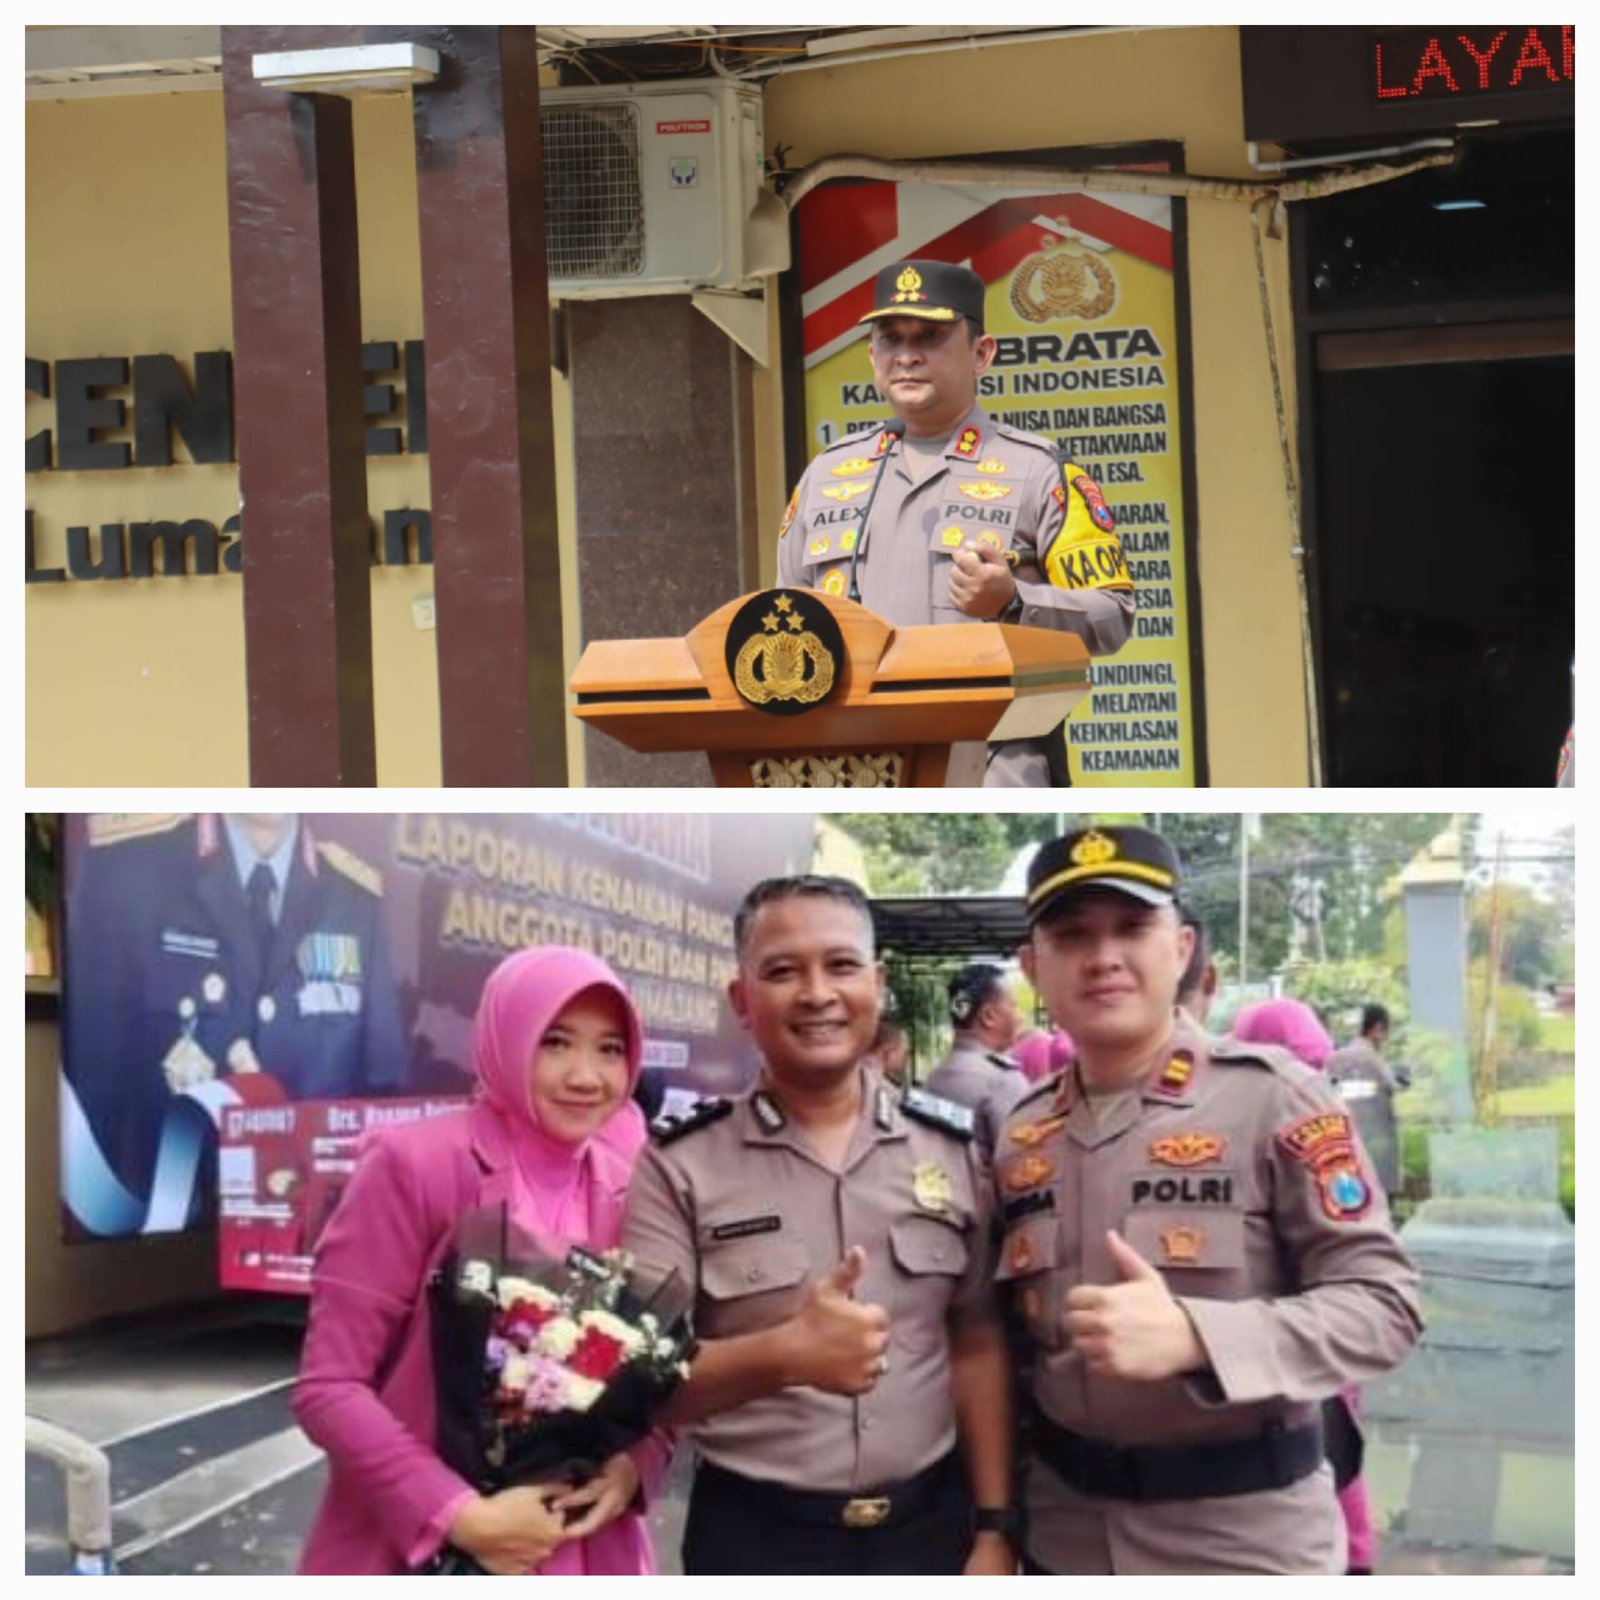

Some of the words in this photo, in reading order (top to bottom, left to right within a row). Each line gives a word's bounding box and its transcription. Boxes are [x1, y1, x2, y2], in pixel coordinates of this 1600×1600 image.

[1375, 25, 1575, 99] LAYA
[842, 384, 886, 405] KA
[1013, 366, 1165, 394] INDONESIA
[820, 424, 830, 445] 1
[1054, 407, 1089, 429] DAN
[1093, 403, 1166, 427] BANGSA
[1057, 432, 1166, 457] KETAKWAAN
[1108, 461, 1145, 482] ESA.
[813, 506, 867, 527] ALEX
[945, 504, 1012, 526] POLRI
[1117, 531, 1169, 553] ALAM
[1060, 549, 1099, 589] KA
[1134, 588, 1173, 610] ESIA
[1138, 617, 1173, 637] DAN
[1092, 691, 1177, 715] MELAYANI
[1069, 720, 1178, 744] KEIKHLASAN
[1082, 748, 1180, 772] KEAMANAN
[397, 813, 563, 896] LAPORAN
[442, 890, 593, 949] ANGGOTA
[1132, 1178, 1232, 1204] POLRI
